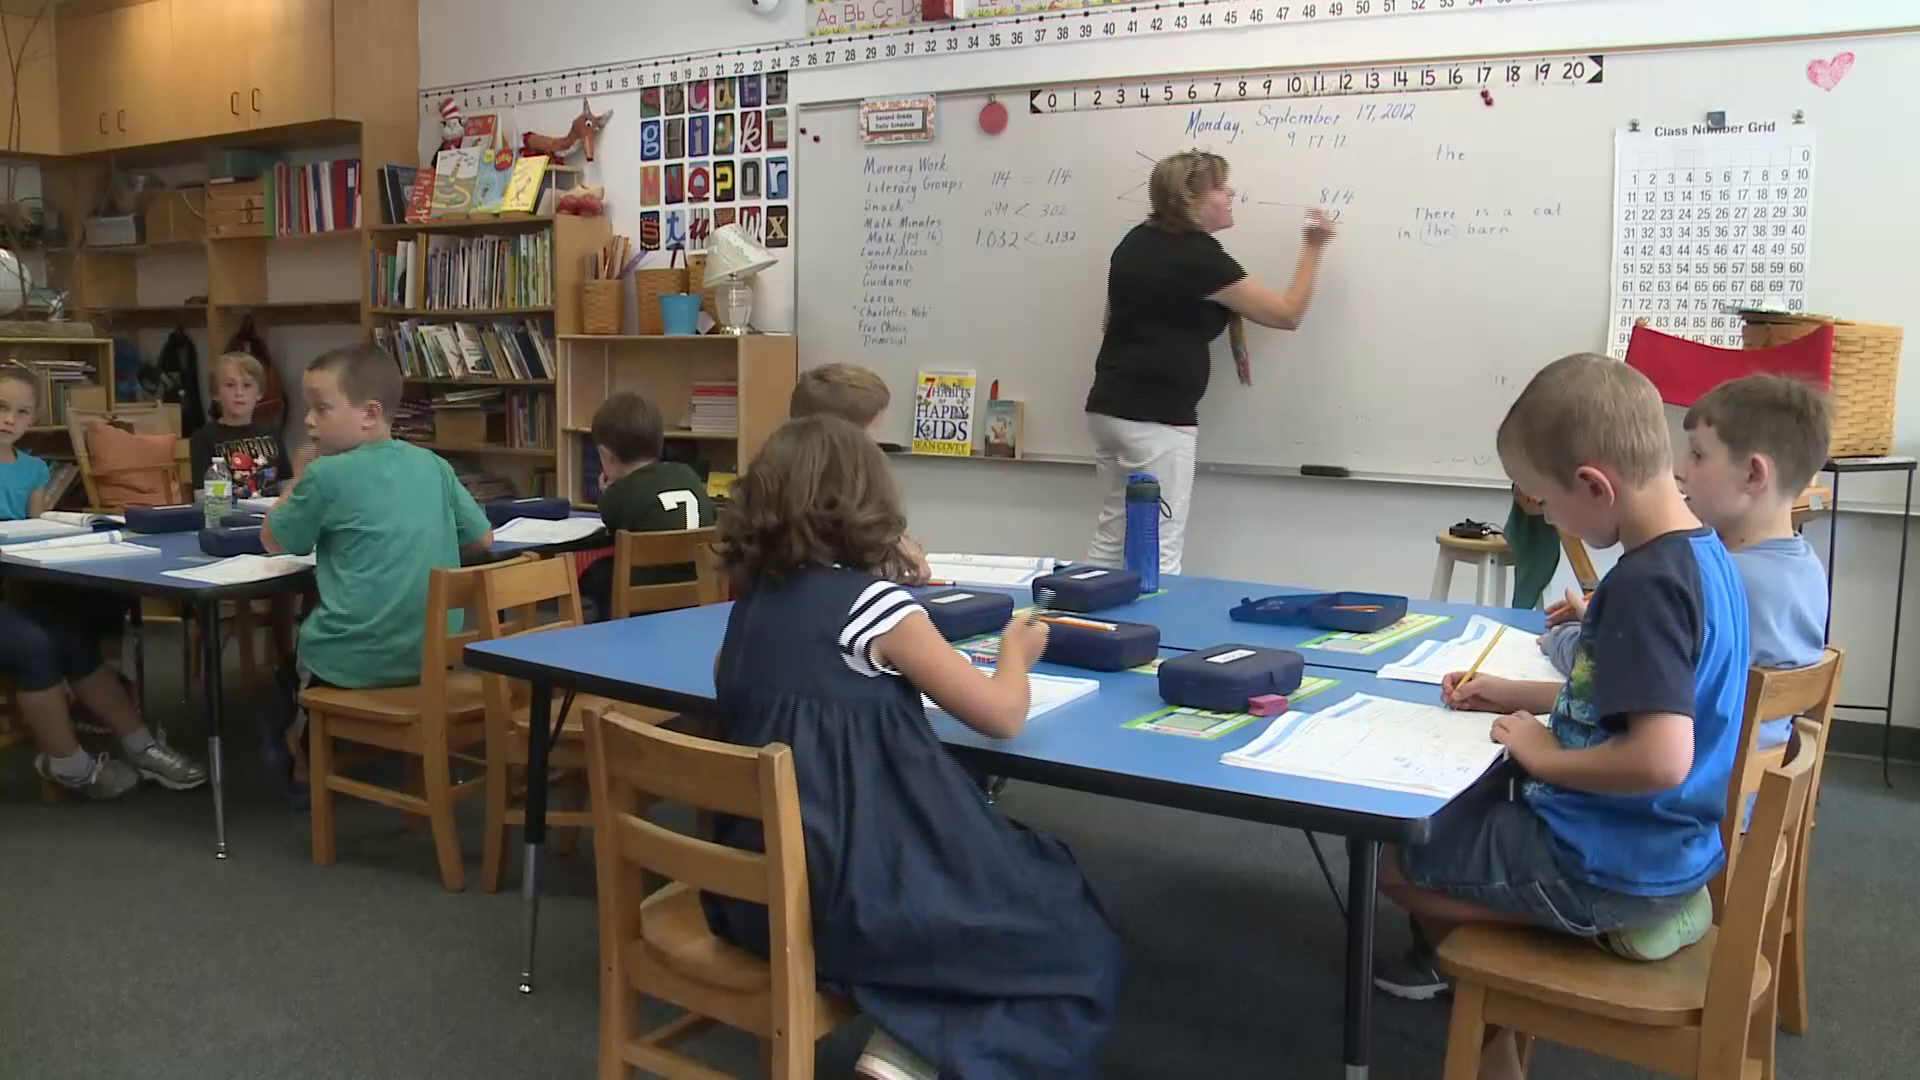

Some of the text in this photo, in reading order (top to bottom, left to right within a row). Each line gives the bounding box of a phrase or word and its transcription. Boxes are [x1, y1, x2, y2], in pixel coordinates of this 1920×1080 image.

[816, 8, 837, 26] Aa
[844, 4, 865, 23] Bb
[872, 0, 893, 19] Cc
[789, 11, 1238, 68] 25 26 27 28 29 30 31 32 33 34 35 36 37 38 39 40 41 42 43 44 45
[1048, 93, 1057, 108] 0
[1093, 90, 1102, 106] 2
[1116, 88, 1125, 103] 3
[1140, 88, 1150, 103] 4
[1163, 85, 1174, 101] 5
[1188, 84, 1197, 99] 6
[1213, 82, 1222, 98] 7
[1237, 81, 1247, 97] 8
[1263, 79, 1273, 95] 9
[1287, 77, 1301, 93] 10
[1313, 75, 1324, 91] 11
[1339, 73, 1352, 90] 12
[1365, 72, 1380, 89] 13
[1394, 71, 1408, 87] 14
[1421, 69, 1436, 86] 15
[1449, 68, 1463, 85] 16
[1477, 66, 1492, 83] 17
[1506, 65, 1521, 82] 18
[1535, 63, 1551, 80] 19
[1562, 62, 1585, 80] 20
[1255, 104, 1340, 131] September
[1380, 103, 1416, 121] 2012
[1654, 125, 1689, 138] Class
[1748, 121, 1776, 134] Grid
[1436, 143, 1465, 161] the
[1802, 150, 1809, 162] 0
[863, 152, 949, 184] Morning Work
[992, 170, 1012, 187] 114
[1047, 167, 1072, 186] 114
[1632, 169, 1808, 185] 1 2 3 4 5 6 7 8 9 10
[867, 176, 963, 204] Literacy Groups
[1320, 187, 1354, 204] 814
[1627, 187, 1807, 203] 11 12 13 14 15 16 17 18 19 20
[864, 198, 903, 212] Snack
[1415, 202, 1562, 221] There is a cat
[864, 215, 941, 229] Math Minutes
[1397, 227, 1411, 240] in
[1467, 221, 1509, 235] barn
[866, 231, 895, 244] Math
[932, 386, 971, 399] HABITS
[917, 403, 969, 420] HAPPY
[915, 419, 968, 442] KIDS
[914, 440, 936, 450] SEAN
[936, 443, 967, 453] COVEY
